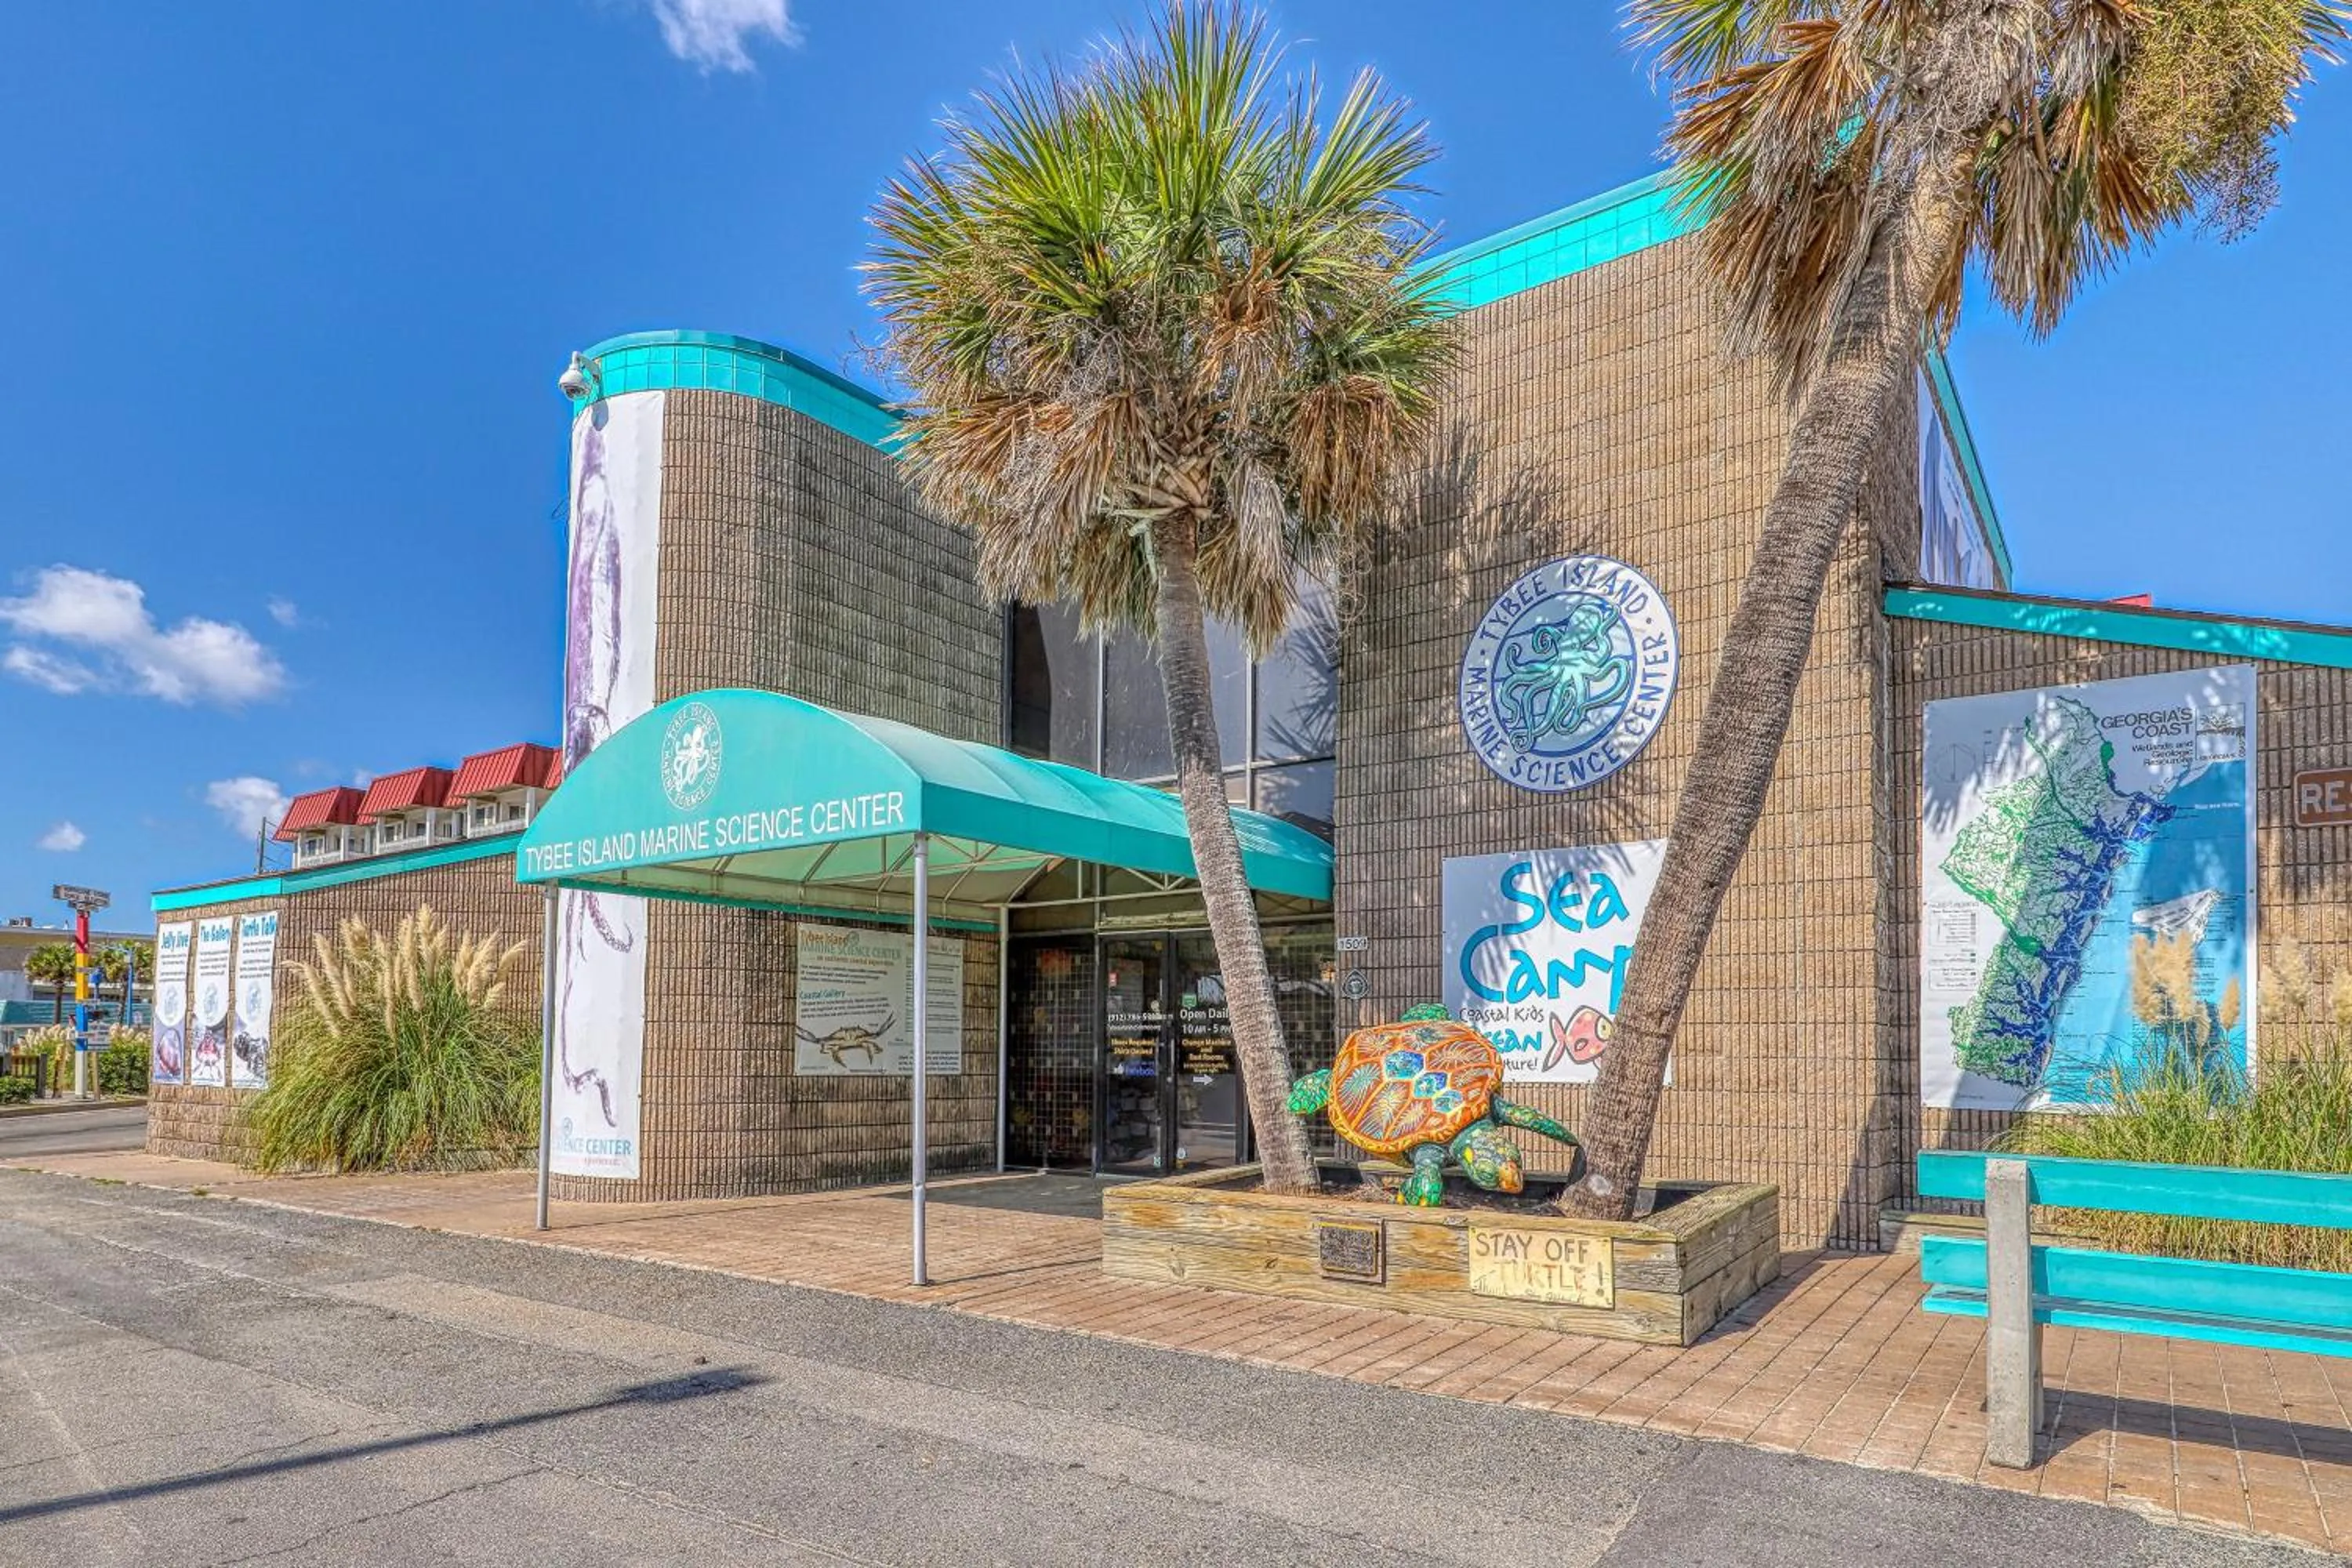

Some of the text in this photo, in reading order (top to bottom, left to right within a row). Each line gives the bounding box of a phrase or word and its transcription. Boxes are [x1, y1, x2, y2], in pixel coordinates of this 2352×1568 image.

[1479, 564, 1648, 642] TYBEE ISLAND
[1467, 630, 1670, 786] MARINE SCIENCE CENTER
[2101, 707, 2193, 729] GEORGIA'S
[2132, 722, 2193, 739] COAST
[2301, 781, 2352, 815] RE
[526, 791, 904, 873] TYBEE ISLAND MARINE SCIENCE CENTER
[1500, 862, 1629, 935] Sea
[1180, 1008, 1229, 1021] Open Dail
[1460, 1004, 1544, 1022] Coastal Kids
[586, 1138, 632, 1155] CENTER
[1475, 1232, 1590, 1263] STAY OFF
